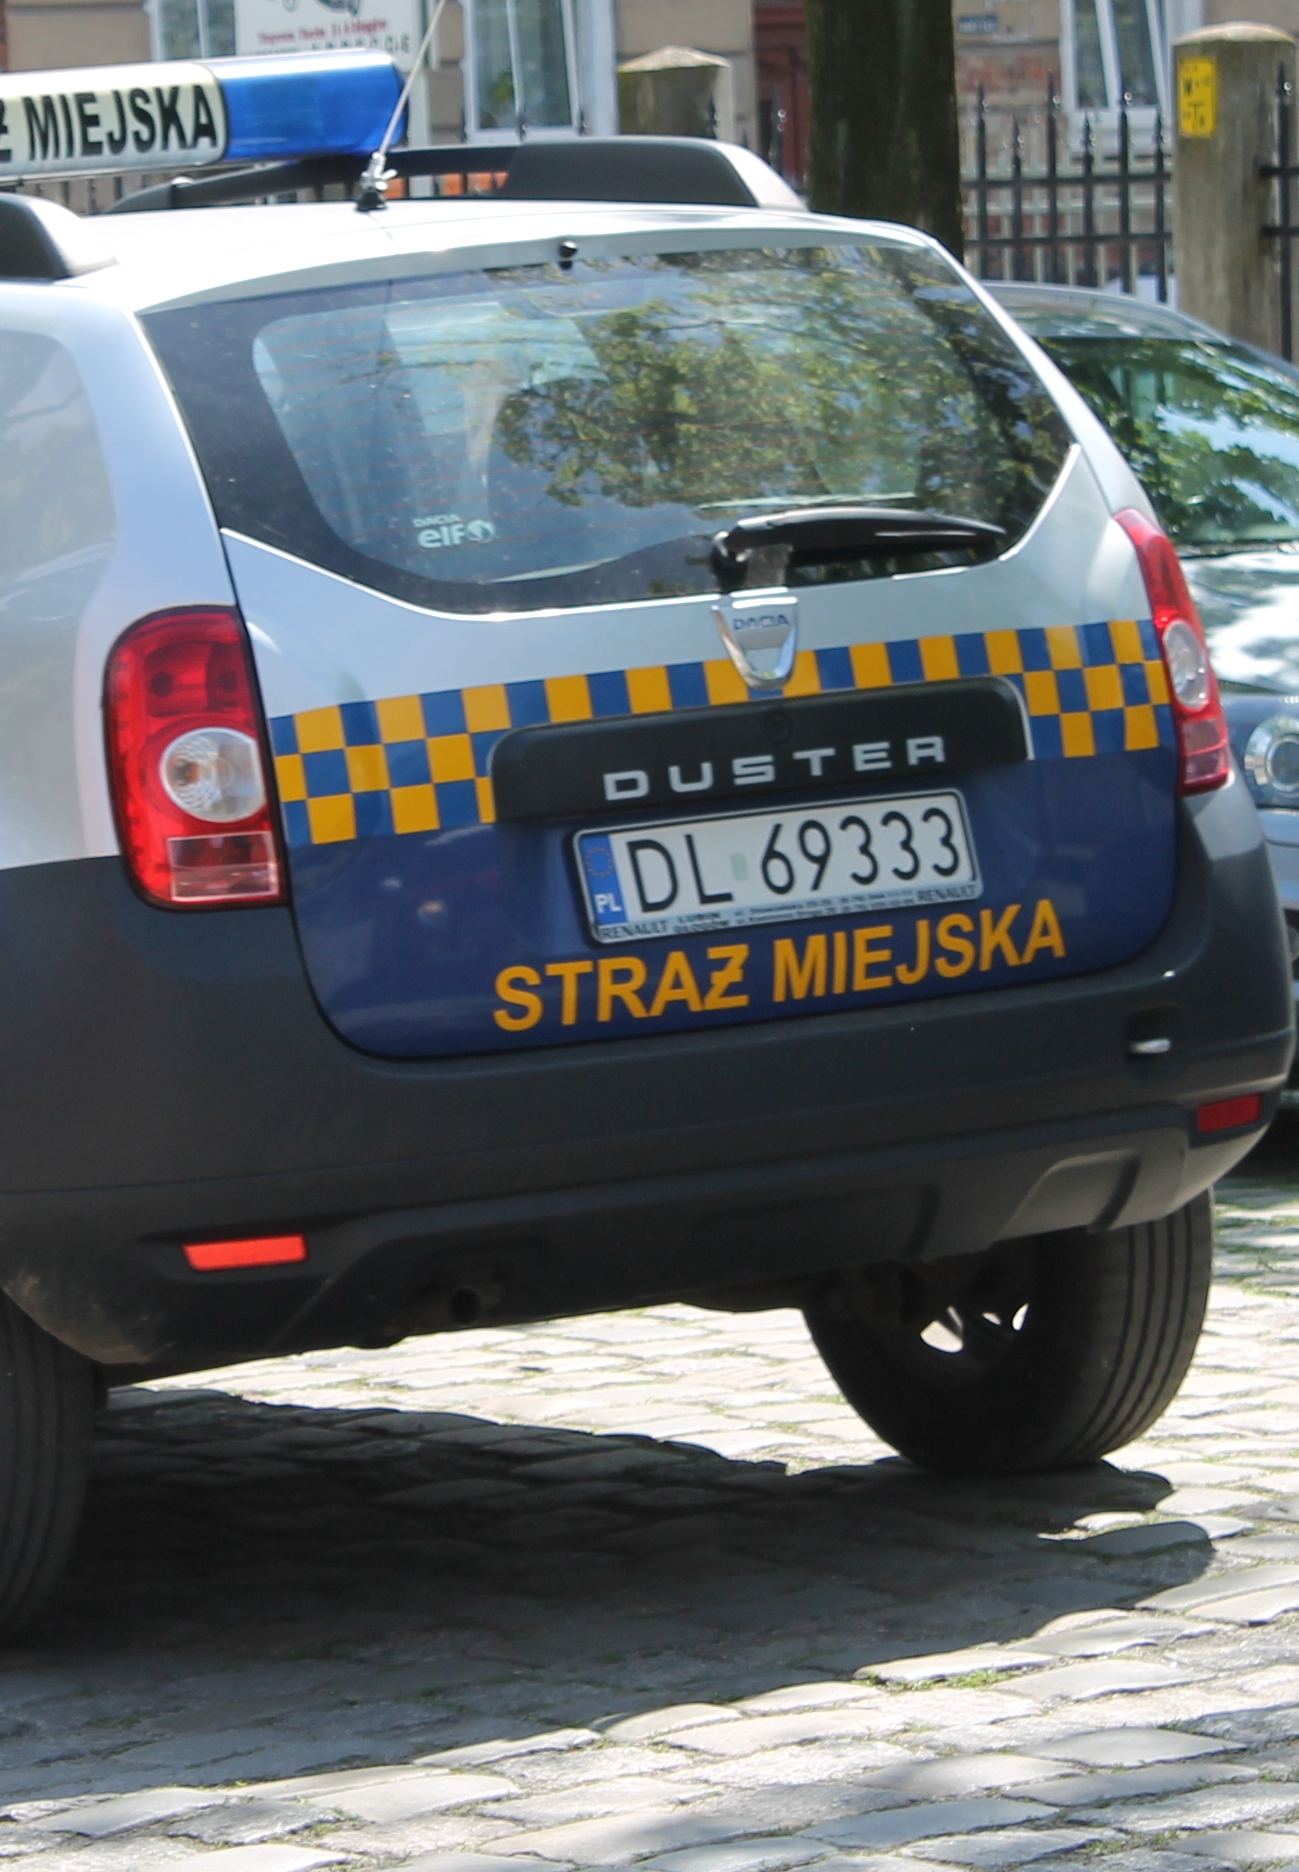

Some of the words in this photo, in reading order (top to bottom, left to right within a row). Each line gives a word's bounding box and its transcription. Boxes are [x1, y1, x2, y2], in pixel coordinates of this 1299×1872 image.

[21, 84, 218, 162] MIEJSKA
[418, 523, 465, 549] elf
[733, 614, 789, 630] DACIA
[603, 736, 946, 801] DUSTER
[627, 834, 733, 914] DL
[761, 807, 959, 895] 69333
[594, 892, 623, 914] PL
[917, 884, 976, 901] RENAULT
[601, 920, 668, 940] RENAULT
[772, 898, 1067, 1003] MIEJSKA
